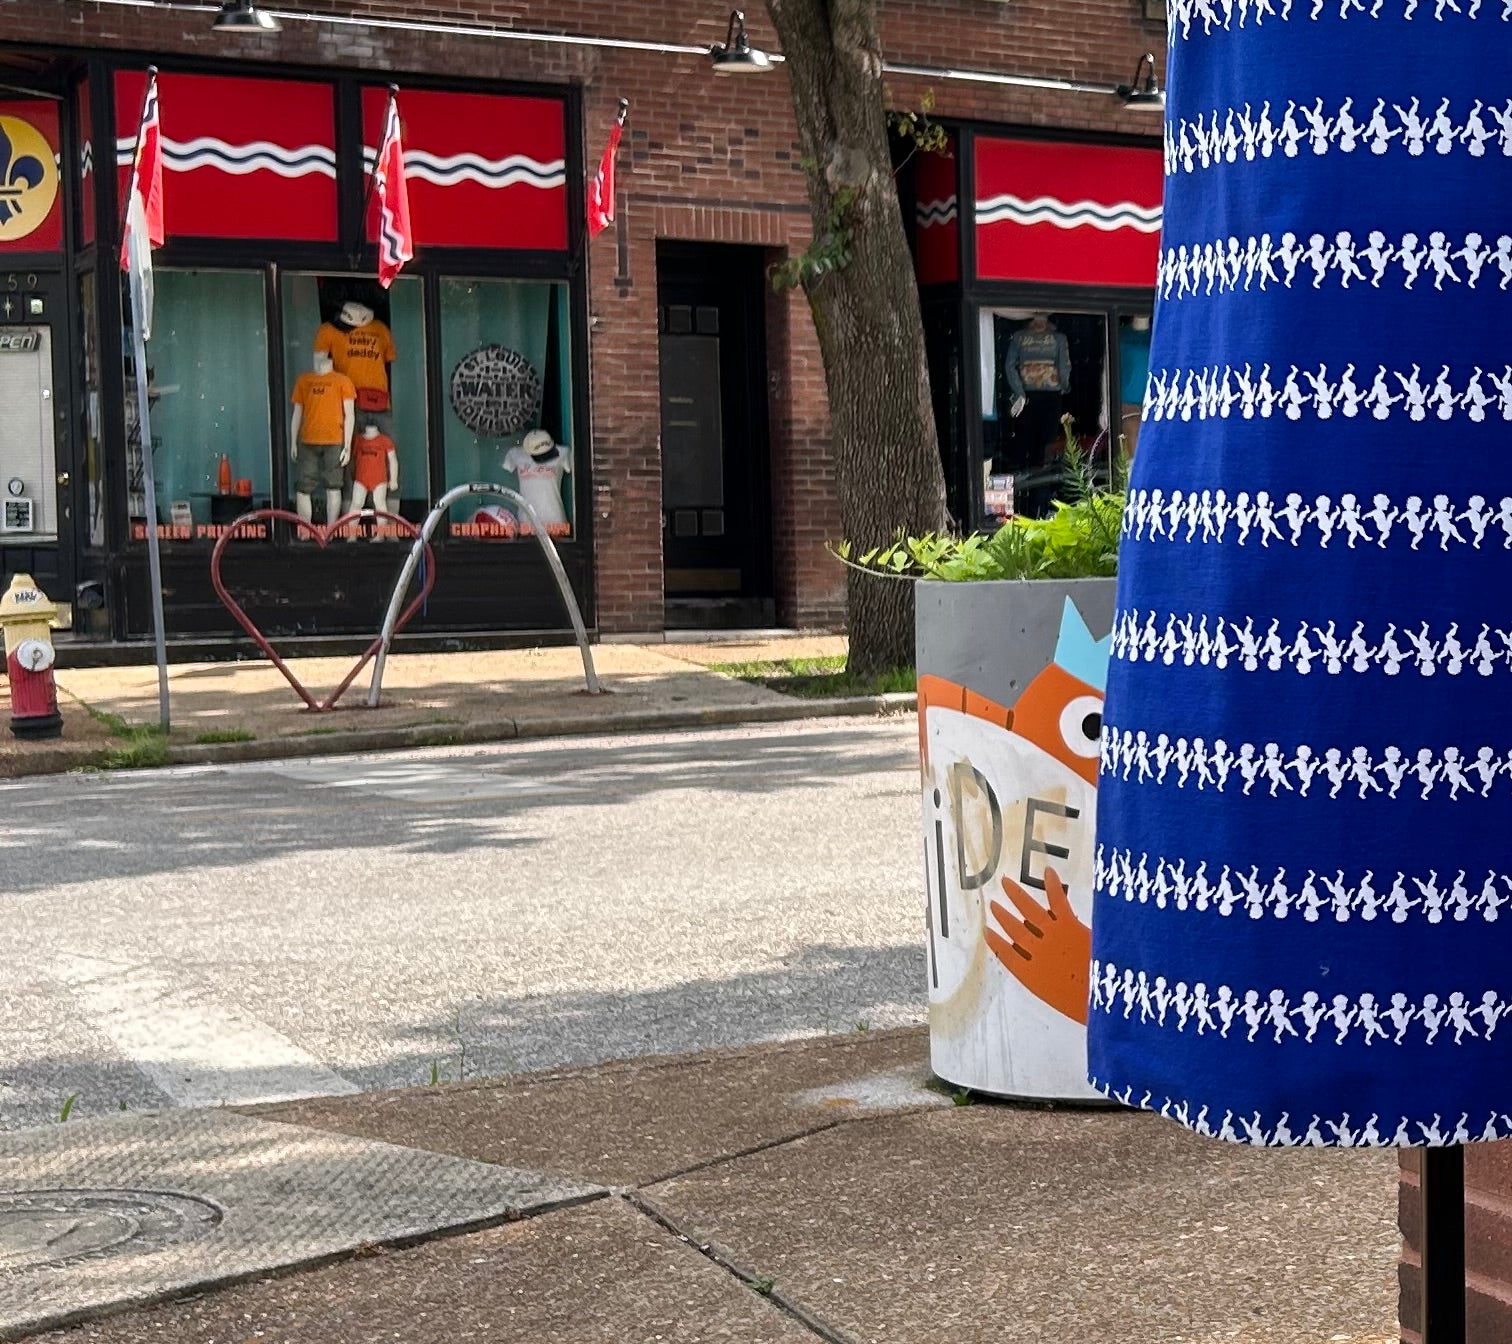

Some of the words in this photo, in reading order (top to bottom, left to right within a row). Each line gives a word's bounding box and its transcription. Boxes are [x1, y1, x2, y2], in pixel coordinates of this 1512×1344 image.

[0, 334, 33, 350] PEN
[460, 381, 532, 398] WATER
[134, 524, 191, 539] SREEN
[520, 522, 570, 536] DEIGN
